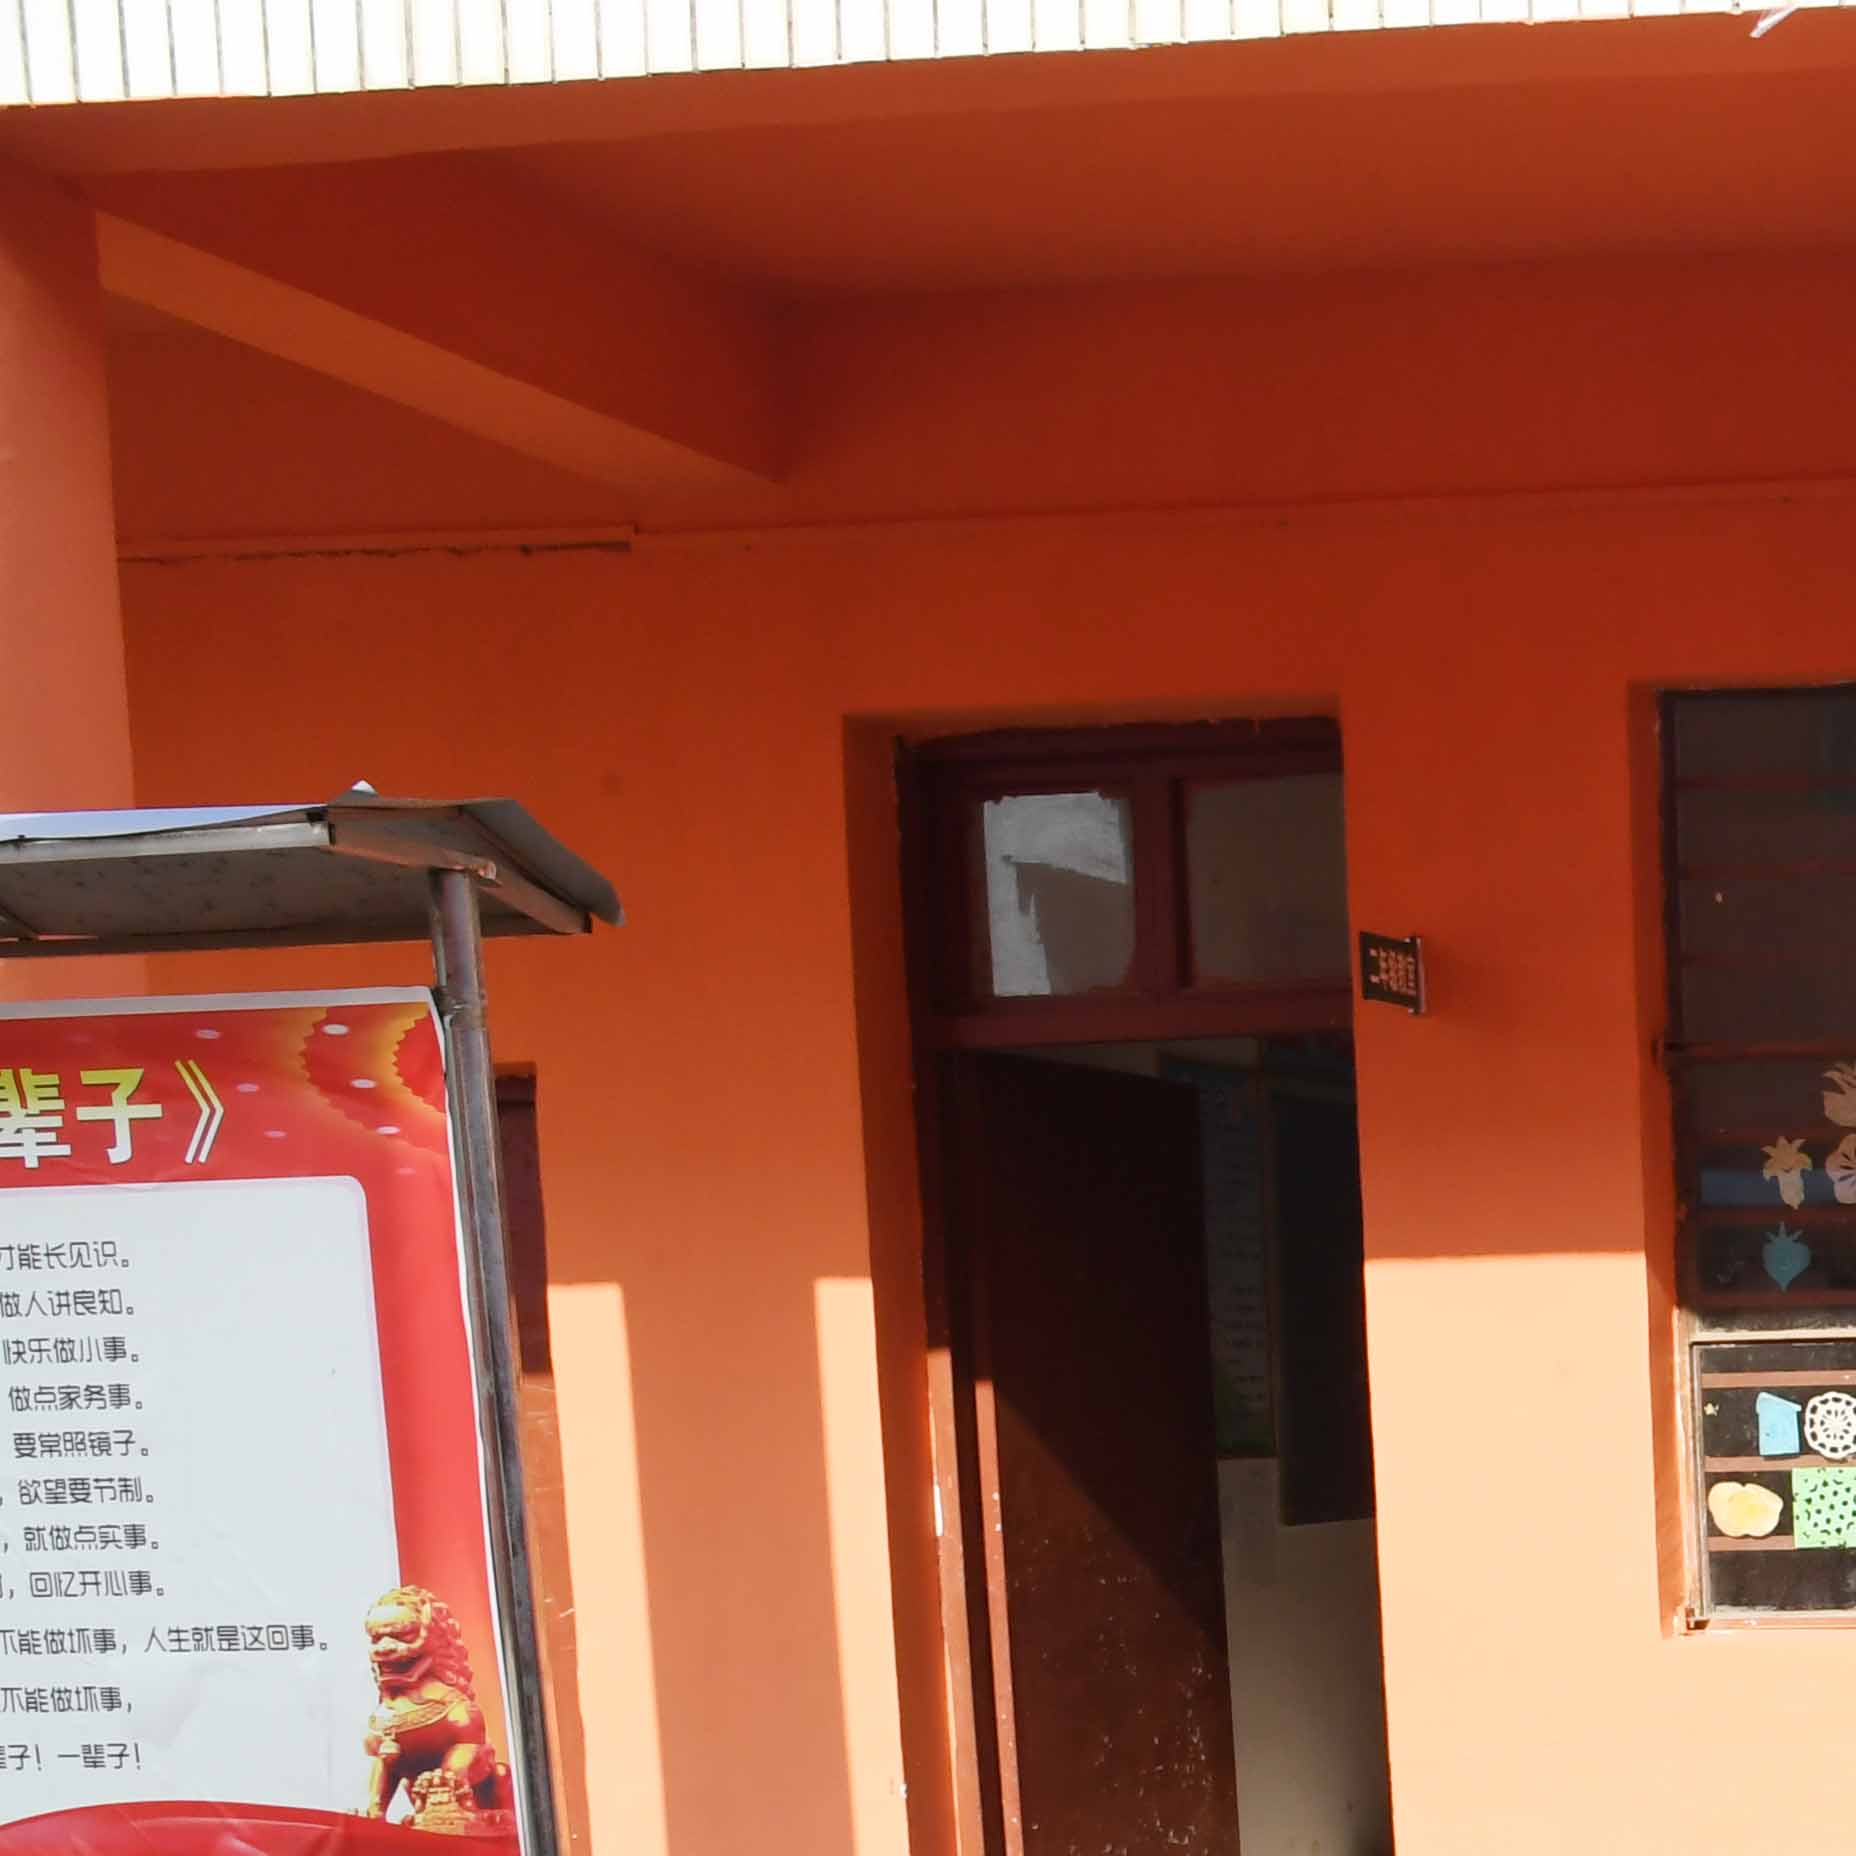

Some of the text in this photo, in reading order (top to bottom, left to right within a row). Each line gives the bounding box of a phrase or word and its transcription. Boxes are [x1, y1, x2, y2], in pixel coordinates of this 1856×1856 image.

[2, 1335, 140, 1365] 快乐做小事。
[8, 1383, 144, 1412] 做点家务事。
[12, 1429, 150, 1459] 要常照镜子。
